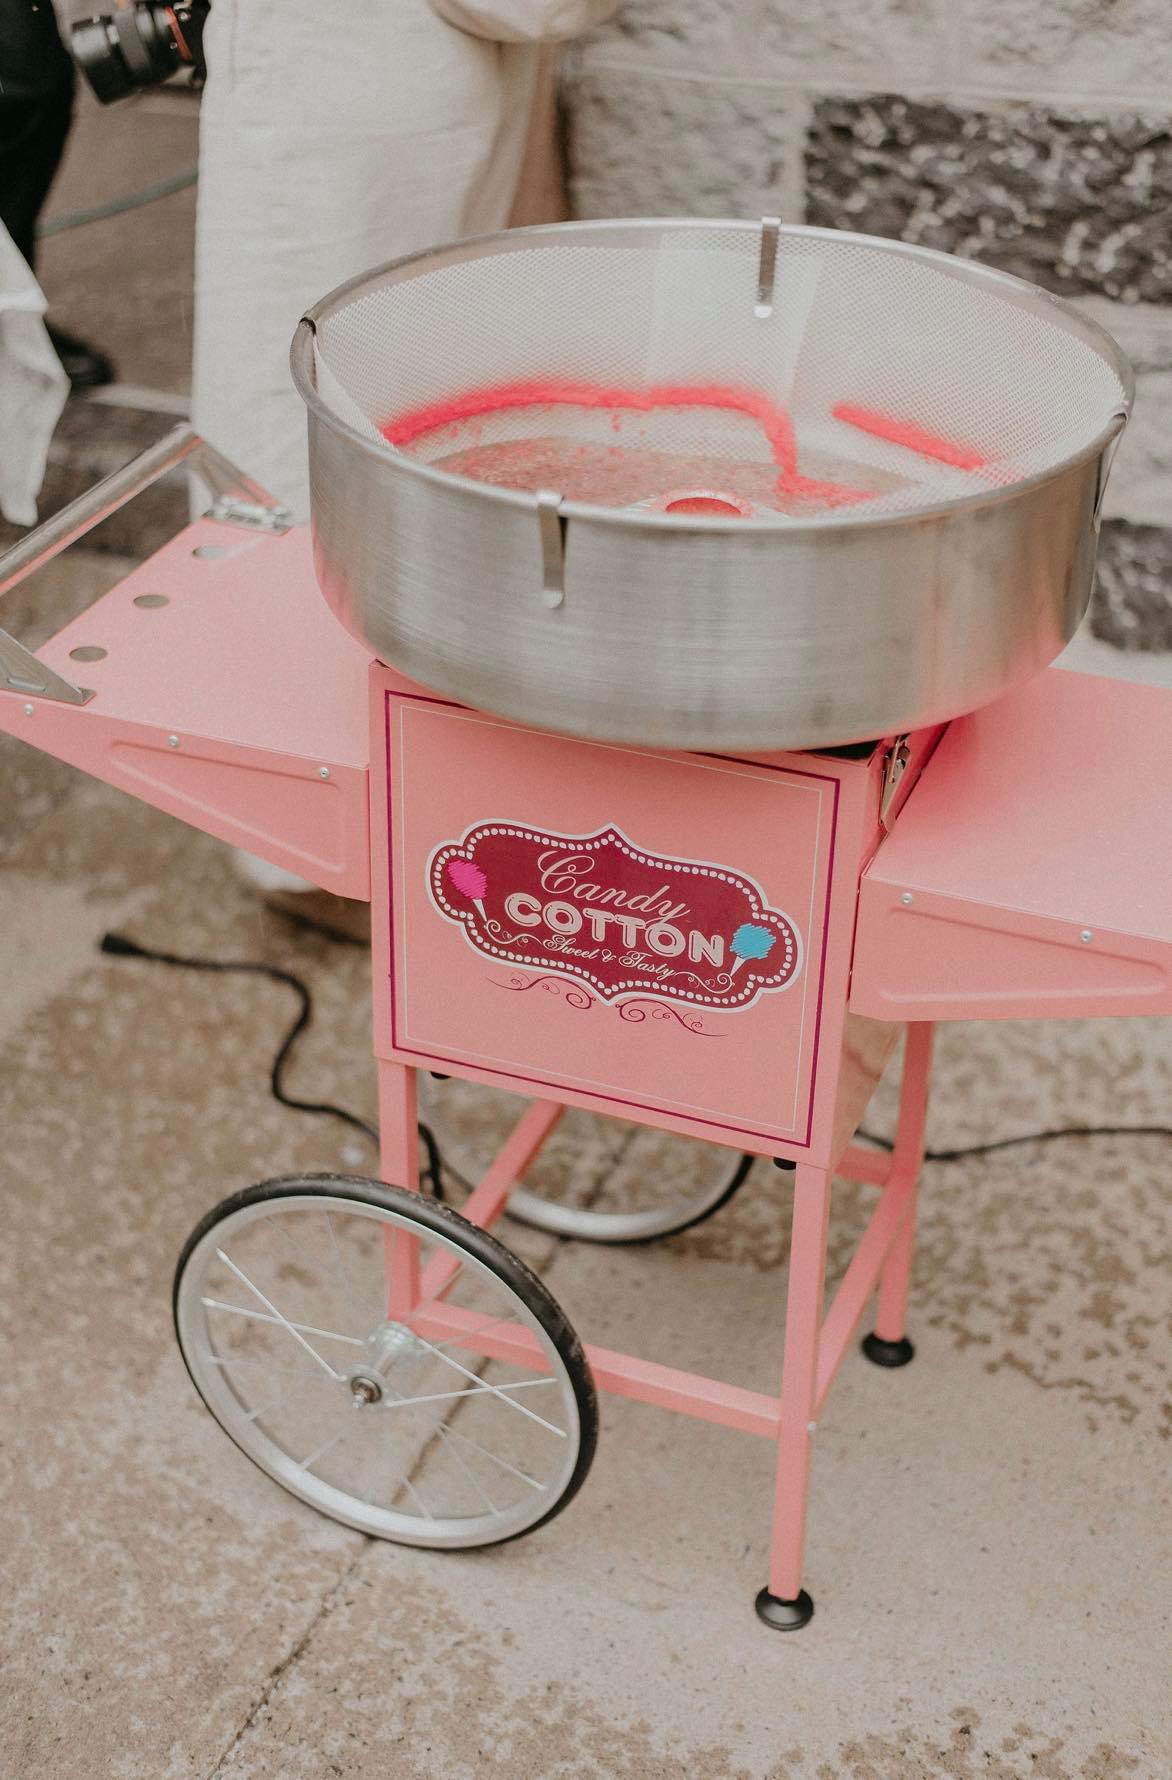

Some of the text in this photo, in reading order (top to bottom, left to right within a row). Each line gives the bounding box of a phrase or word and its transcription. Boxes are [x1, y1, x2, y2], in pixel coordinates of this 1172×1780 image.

[537, 850, 690, 925] Candy
[504, 892, 725, 967] COTTON
[543, 934, 676, 980] Sweet & Tasty
